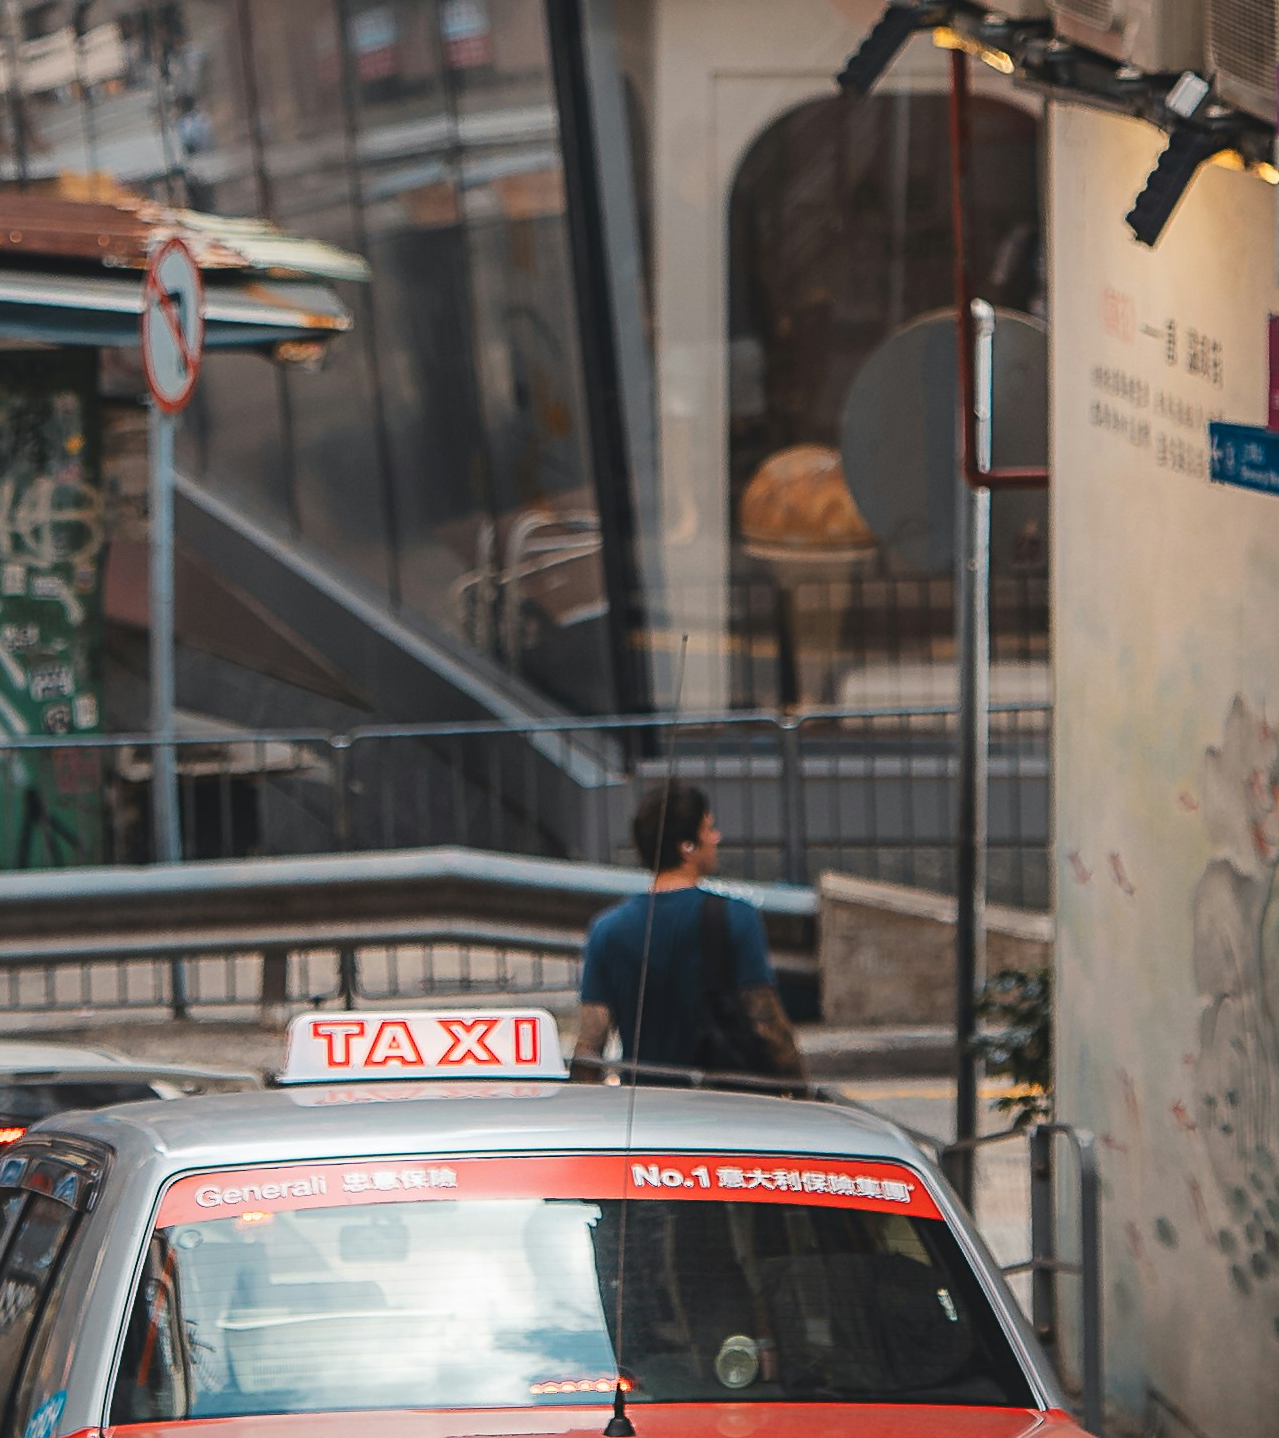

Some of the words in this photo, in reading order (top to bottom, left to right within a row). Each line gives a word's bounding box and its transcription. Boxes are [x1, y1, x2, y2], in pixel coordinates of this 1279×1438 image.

[311, 1017, 540, 1068] TAXI
[195, 1174, 328, 1209] Generali
[342, 1167, 458, 1194] 忠意保險
[631, 1163, 712, 1189] No.1
